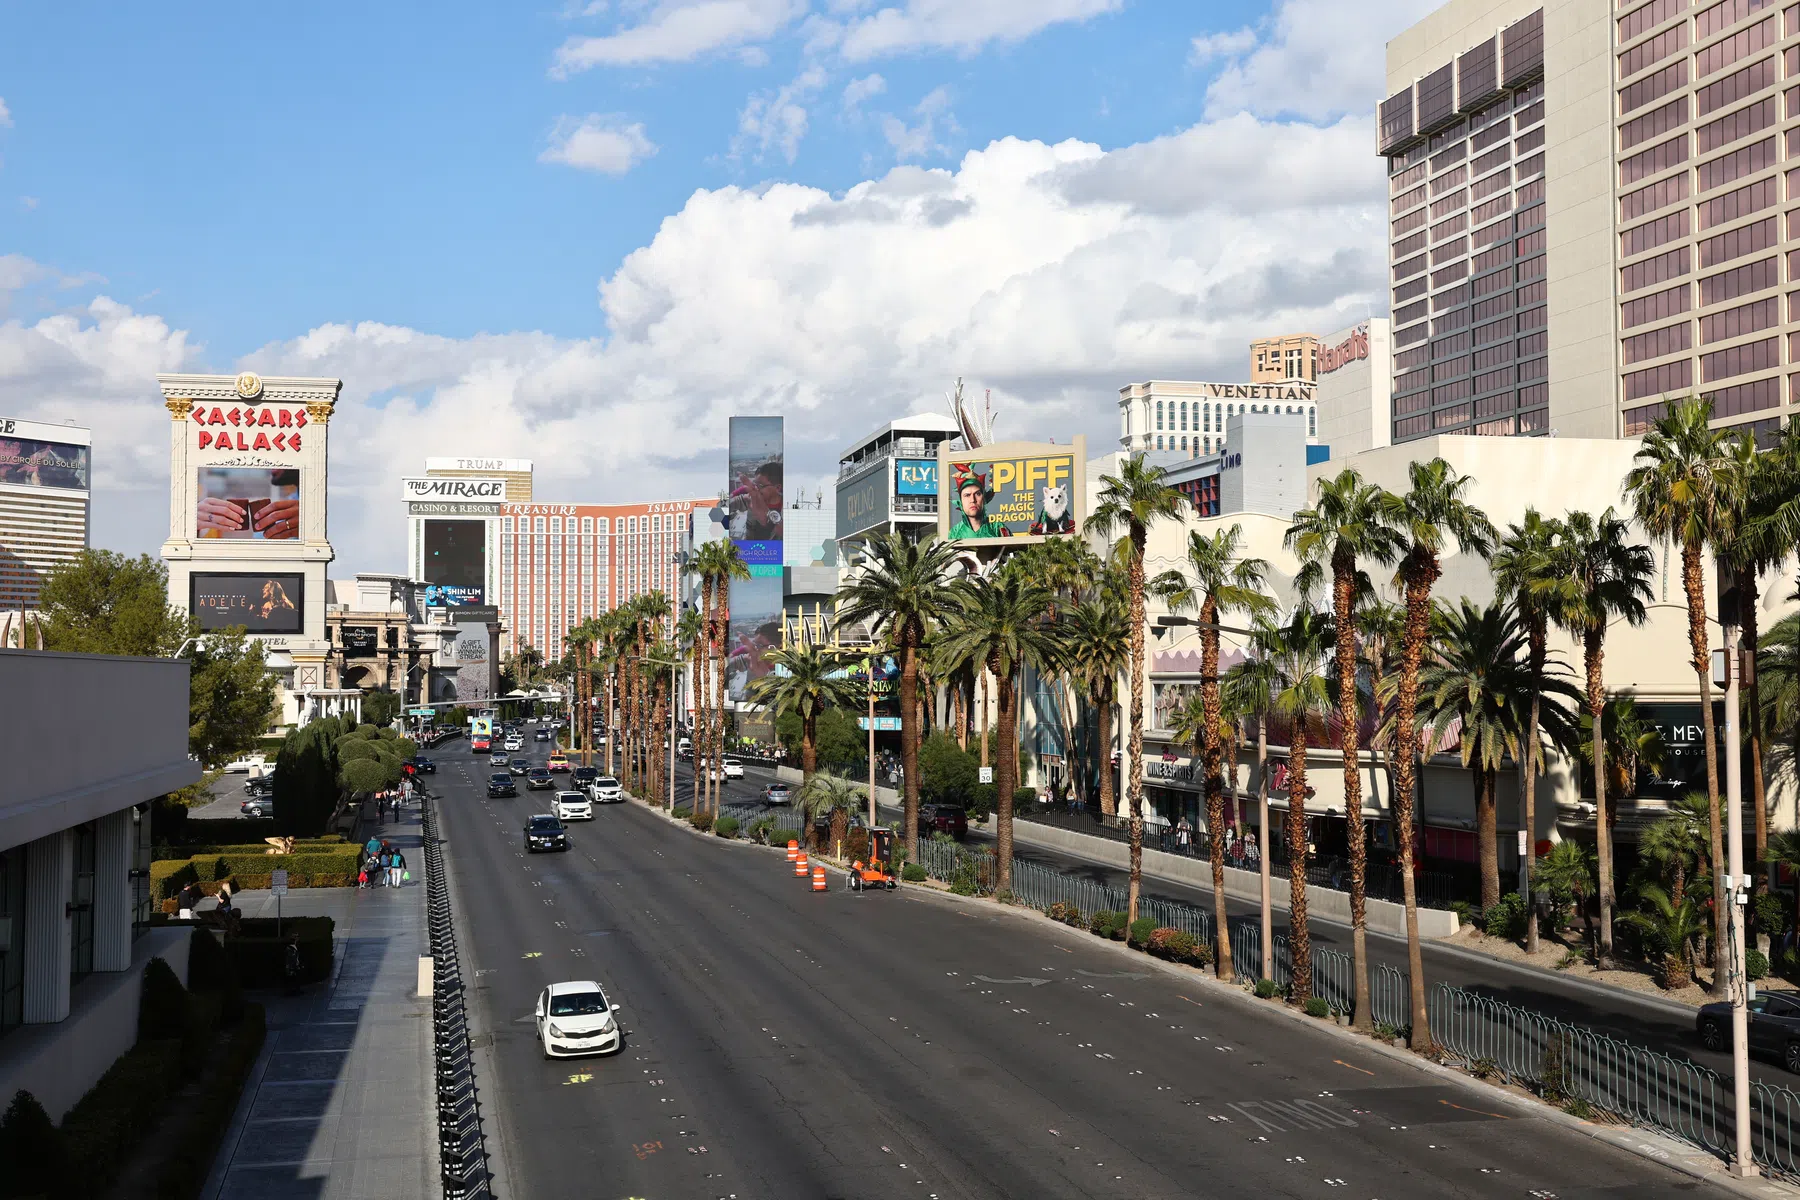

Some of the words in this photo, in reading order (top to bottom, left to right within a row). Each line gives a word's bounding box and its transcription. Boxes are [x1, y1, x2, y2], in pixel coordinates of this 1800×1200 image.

[1209, 384, 1312, 401] VENETIAN
[191, 406, 308, 429] CAESARS
[198, 430, 302, 452] PALACE
[12, 457, 41, 467] CIRQUE
[43, 459, 54, 467] DU
[457, 459, 503, 470] TRUMP
[992, 457, 1070, 493] PIFF
[407, 481, 428, 490] THE
[416, 482, 502, 497] MIRAGE
[1013, 492, 1035, 503] THE
[411, 504, 448, 513] CASINO
[450, 504, 457, 513] &
[459, 505, 499, 513] RESORT
[503, 504, 577, 516] TREASURE
[647, 502, 691, 513] ISLAND
[999, 502, 1035, 513] MAGIC
[988, 511, 1035, 523] DRAGON
[758, 566, 777, 576] OPEN
[447, 588, 465, 596] SHIN
[467, 588, 481, 596] LIM
[199, 598, 246, 607] ADELE
